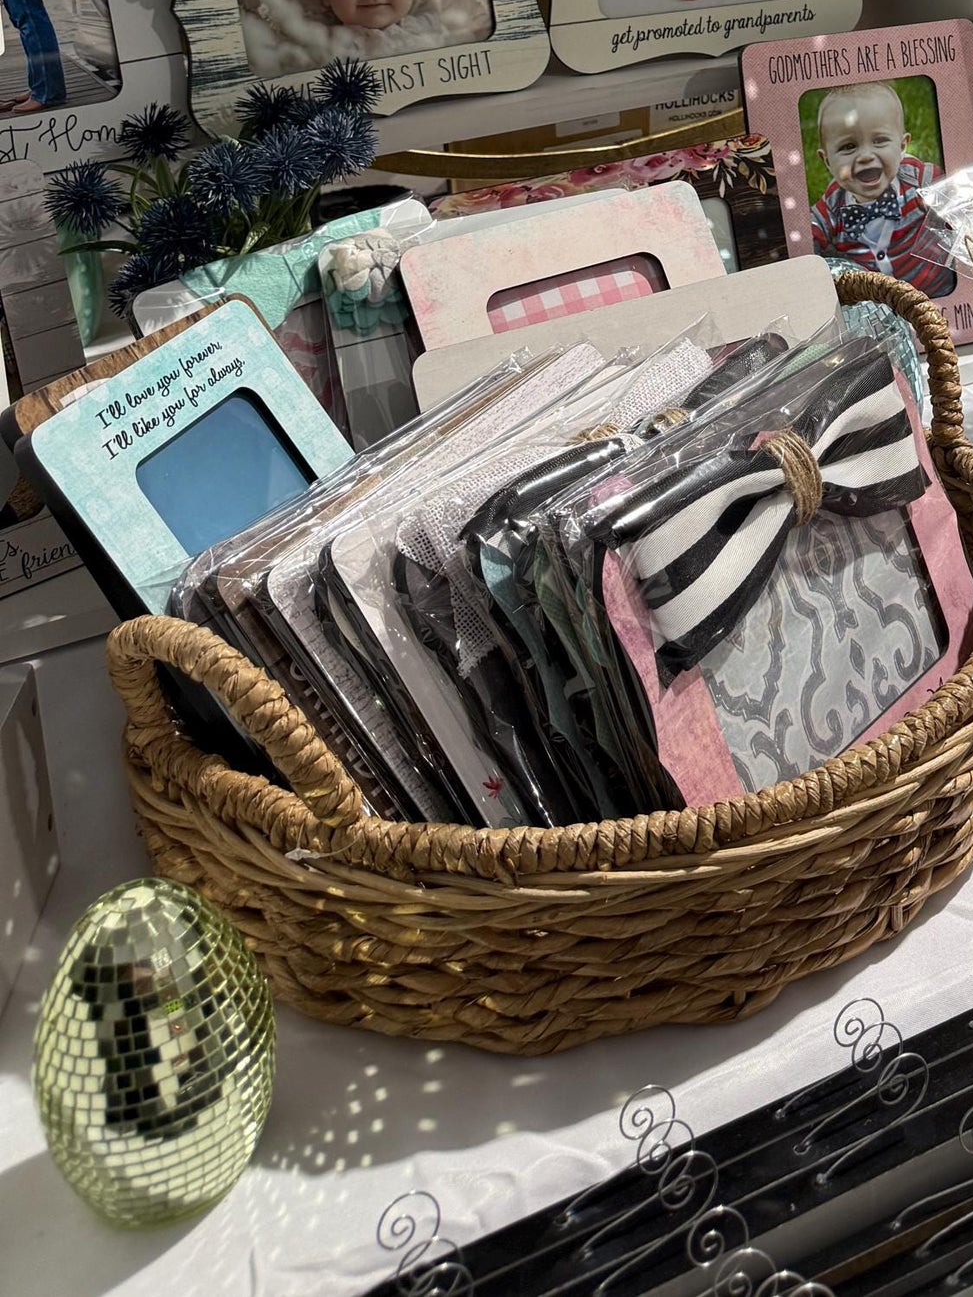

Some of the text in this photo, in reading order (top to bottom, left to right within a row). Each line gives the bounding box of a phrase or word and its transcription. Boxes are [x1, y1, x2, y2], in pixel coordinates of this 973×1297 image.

[611, 4, 816, 53] get promoted to grandparents
[437, 50, 492, 83] SIGHT
[768, 34, 956, 85] GODMOTHERS ARE A BLESSING
[38, 114, 126, 153] Hom
[95, 400, 126, 430] I'll
[125, 385, 155, 408] love
[157, 368, 180, 397] you
[102, 430, 133, 460] I'll
[132, 416, 160, 437] like
[162, 398, 185, 427] you
[183, 383, 206, 408] for
[21, 543, 78, 579] frien
